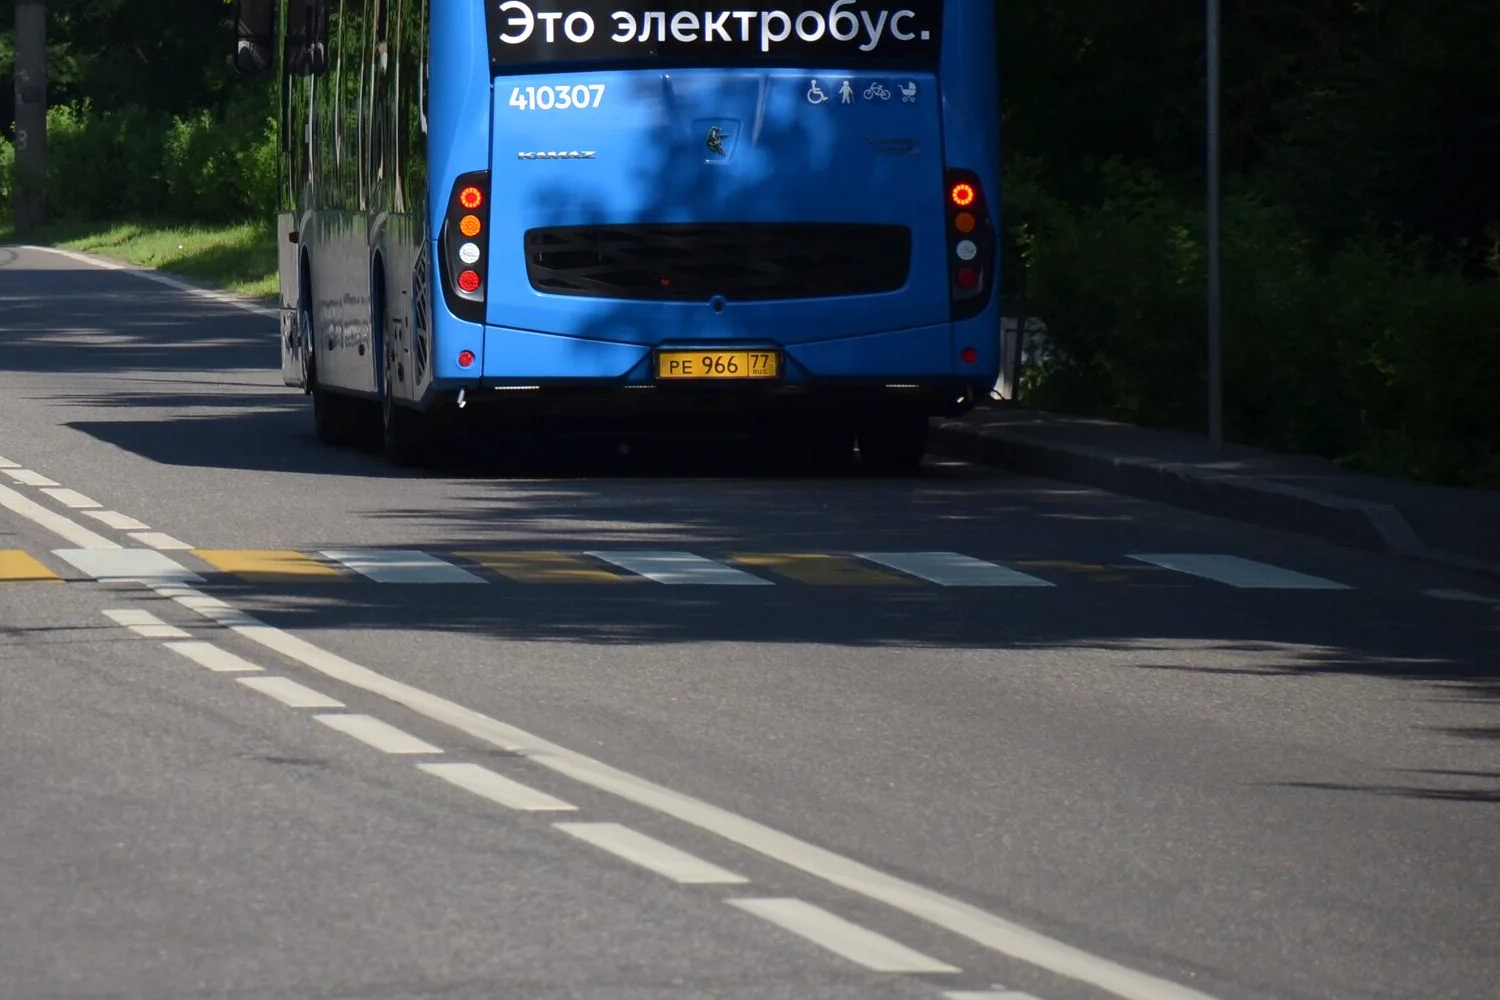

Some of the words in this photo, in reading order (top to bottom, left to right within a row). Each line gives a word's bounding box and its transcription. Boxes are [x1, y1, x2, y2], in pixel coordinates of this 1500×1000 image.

[499, 0, 596, 43] Это
[508, 84, 605, 111] 410307
[702, 355, 739, 375] 966
[750, 354, 770, 369] 77
